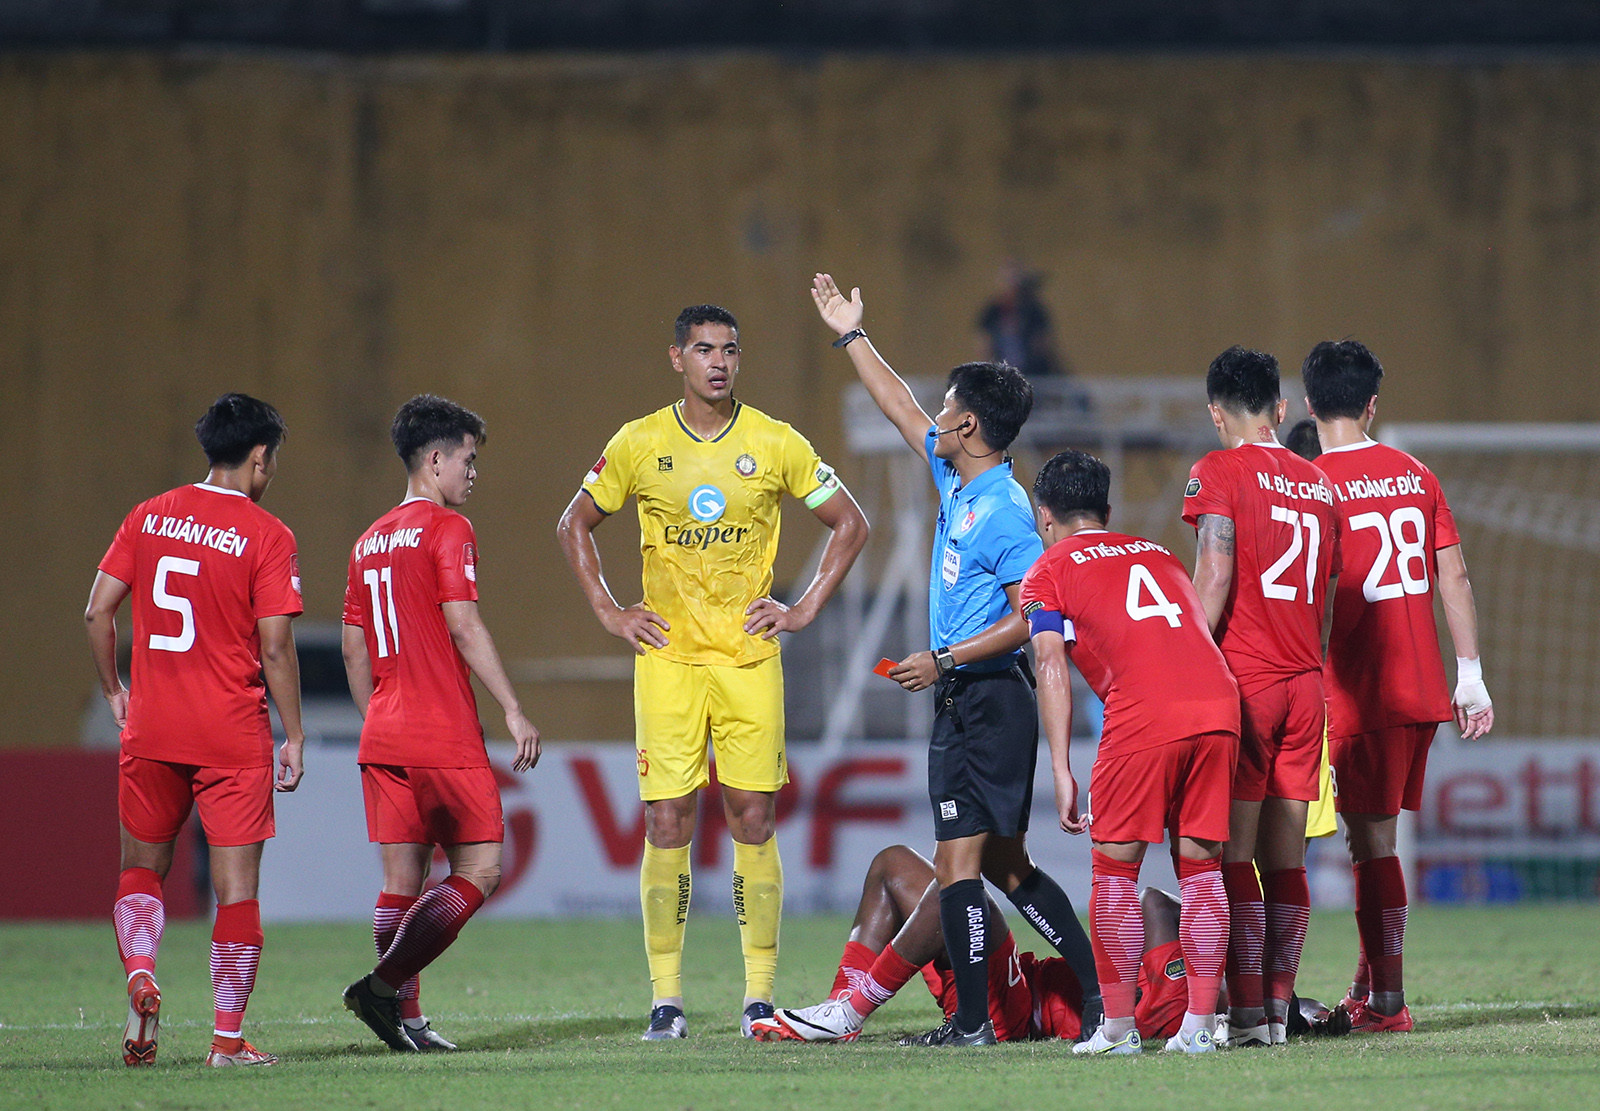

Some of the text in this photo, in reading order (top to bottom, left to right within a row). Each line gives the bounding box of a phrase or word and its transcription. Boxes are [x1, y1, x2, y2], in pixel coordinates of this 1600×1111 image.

[1345, 473, 1398, 500] HOÀNG
[1396, 469, 1426, 496] ĐỨC
[156, 515, 206, 545] XUÂN
[202, 526, 248, 558] KIÊN
[665, 524, 747, 550] Casper
[944, 551, 958, 566] FIFA
[1260, 505, 1321, 604] 21
[1348, 506, 1430, 604] 28
[148, 555, 201, 653] 5
[363, 565, 400, 659] 11
[1125, 563, 1184, 628] 4
[676, 873, 691, 925] JOGARBOLA
[1022, 903, 1063, 946] JOGARBOLA
[966, 905, 985, 964] JOGARBOLA
